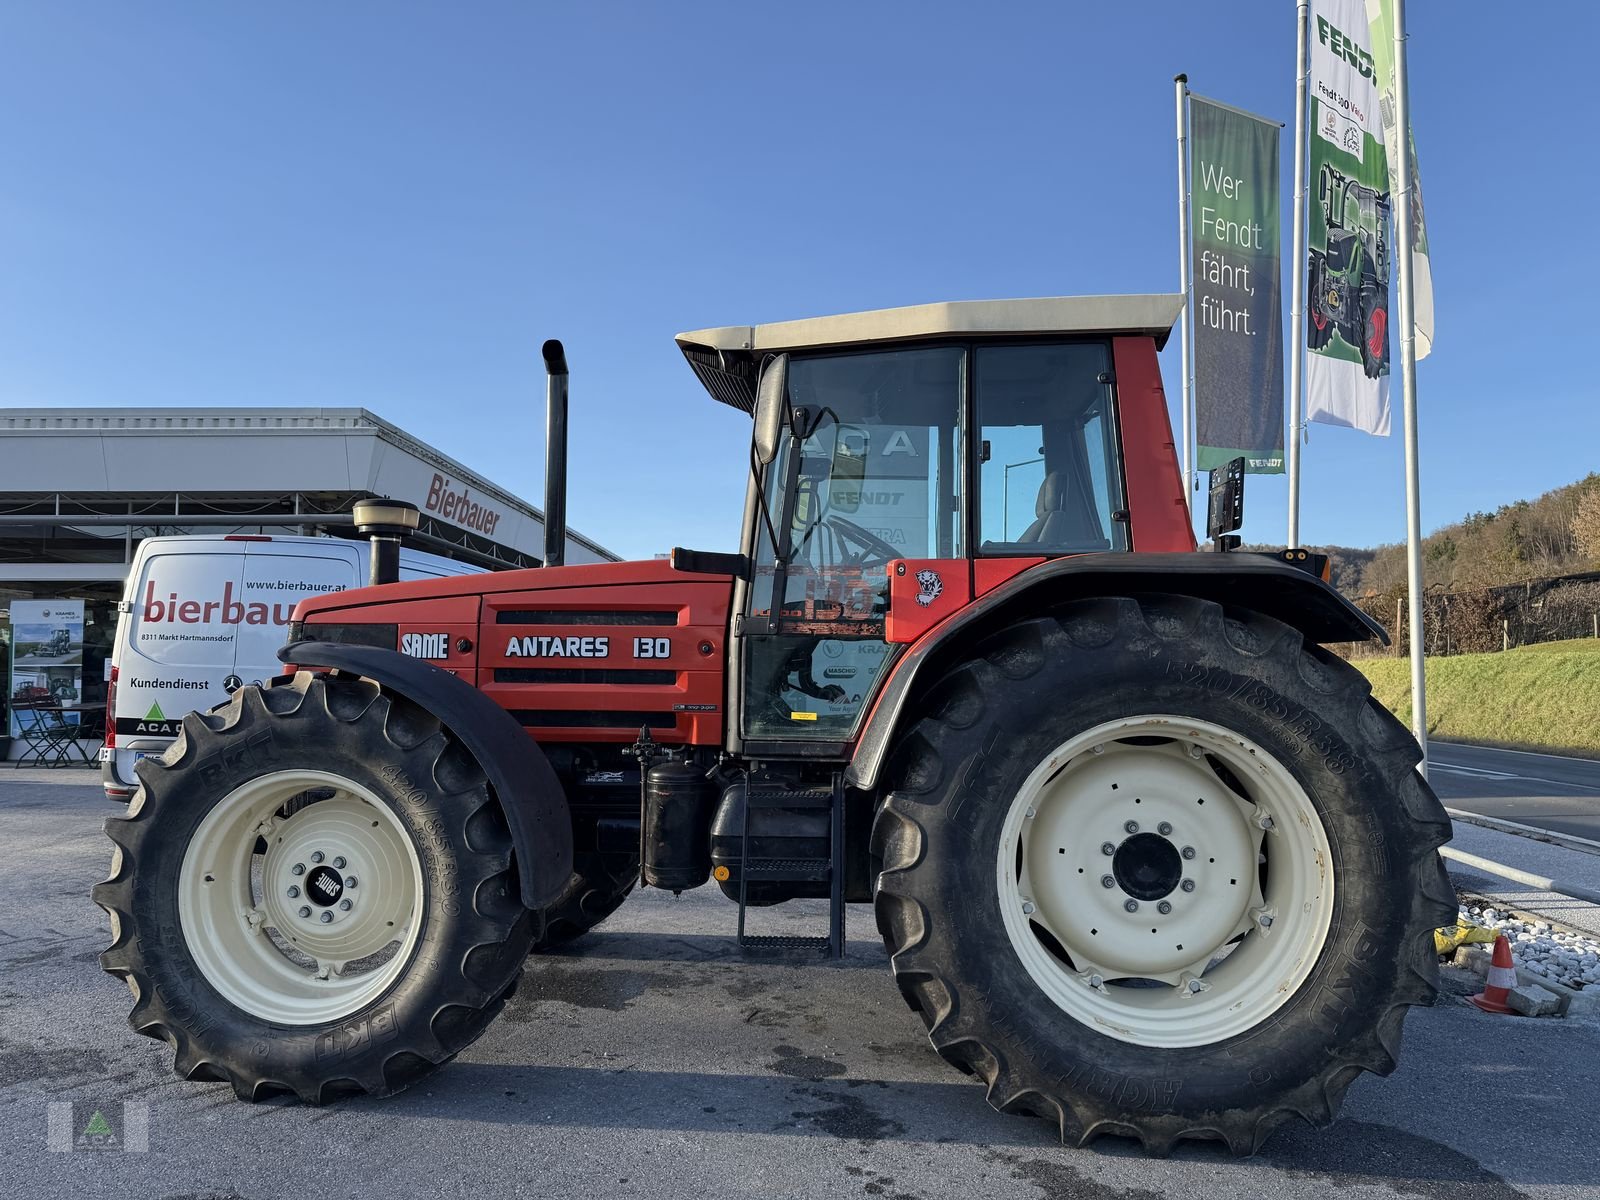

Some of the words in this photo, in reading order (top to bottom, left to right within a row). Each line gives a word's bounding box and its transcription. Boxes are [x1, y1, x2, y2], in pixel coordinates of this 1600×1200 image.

[1200, 161, 1243, 201] Wer
[1201, 206, 1262, 250] Fendt
[1200, 250, 1255, 297] fährt,
[1200, 295, 1256, 336] führt.
[1248, 458, 1282, 468] FENDT
[425, 473, 500, 536] Bierbauer
[832, 491, 905, 505] FENDT
[246, 580, 347, 593] www.bierbauer.at
[141, 633, 157, 641] 8311
[158, 634, 179, 642] Markt
[179, 634, 235, 643] Hartmannsdorf
[401, 633, 449, 659] SAME
[505, 636, 609, 658] ANTARES
[633, 637, 671, 658] 130
[130, 677, 210, 690] Kundendienst
[136, 722, 172, 733] ACA
[380, 762, 462, 918] 420/85R30
[315, 872, 341, 897] SAME
[315, 1001, 399, 1064] BKT
